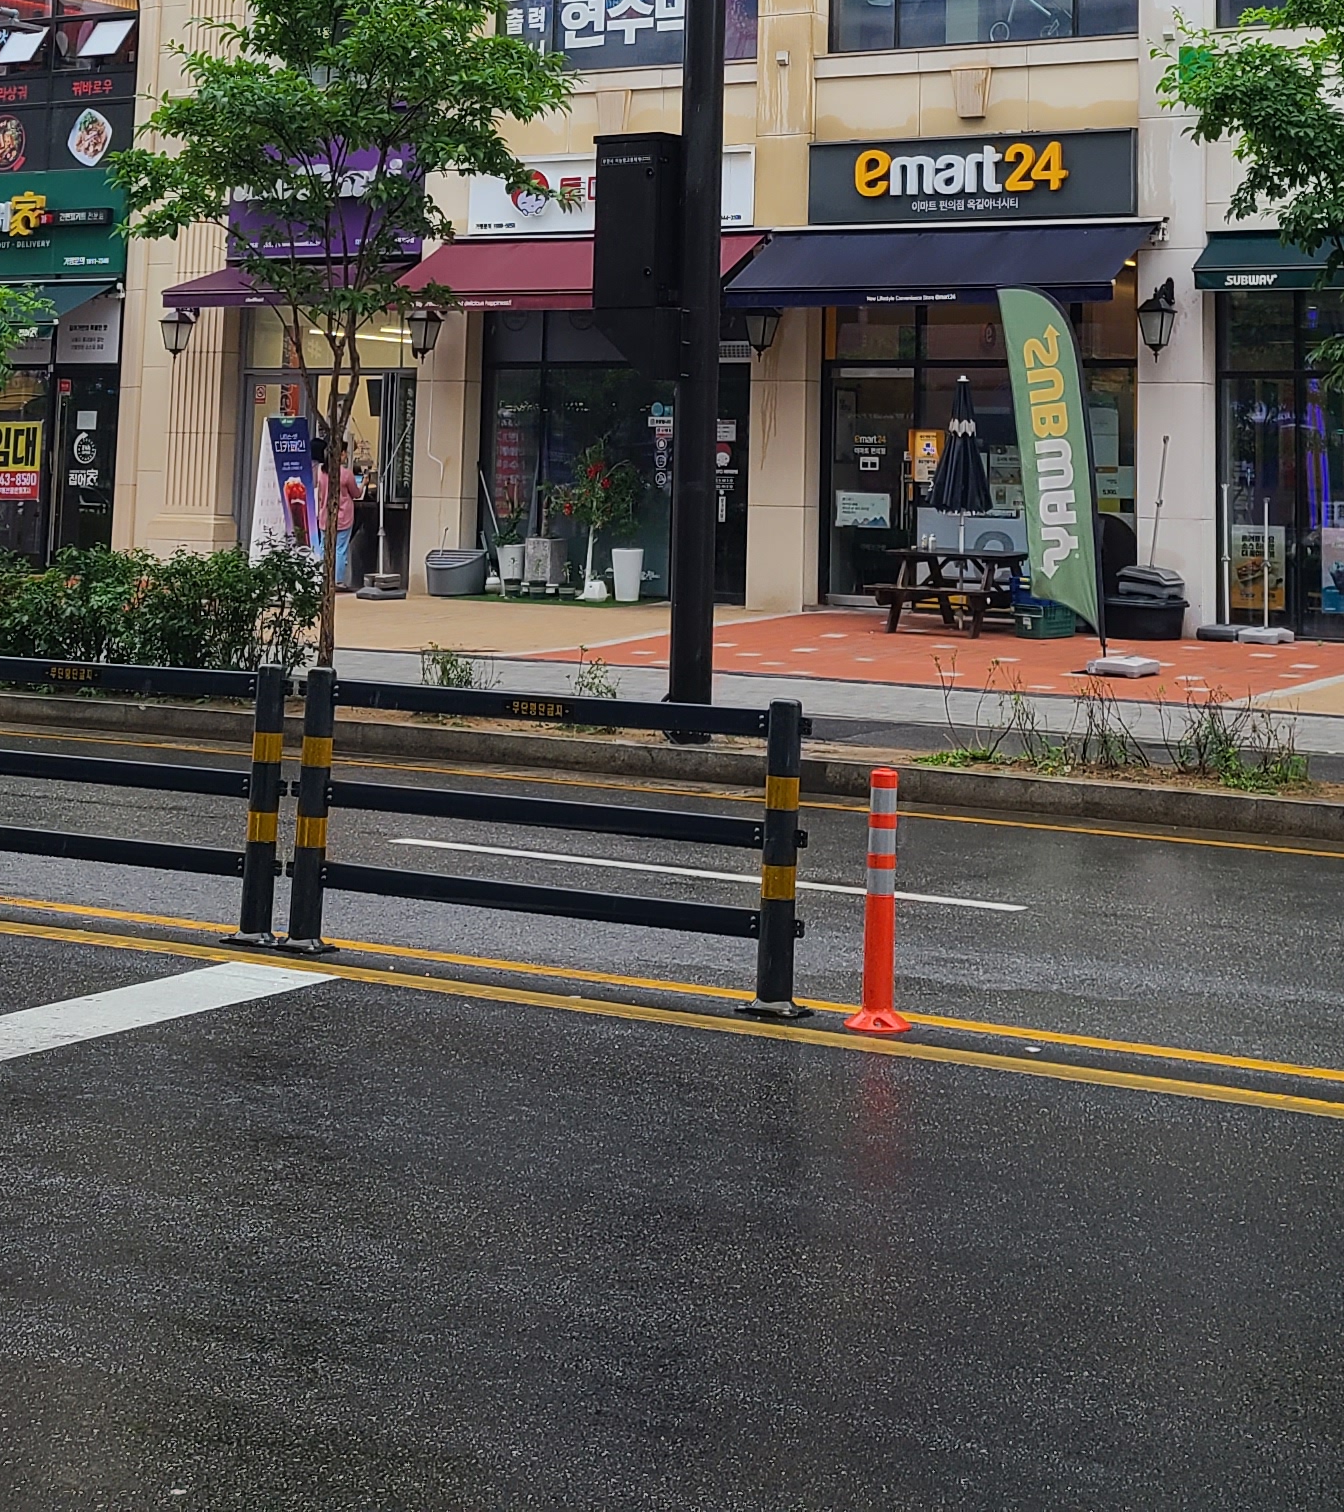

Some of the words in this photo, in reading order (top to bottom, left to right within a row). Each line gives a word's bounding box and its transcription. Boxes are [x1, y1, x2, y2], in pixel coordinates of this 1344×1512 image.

[506, 7, 546, 36] 출력
[854, 140, 1069, 198] emart24
[912, 201, 937, 212] 이마트
[939, 199, 964, 211] 편의점
[967, 197, 1018, 210] 옥길아너시티
[17, 238, 51, 249] DELIVERY
[1225, 274, 1277, 286] SUBWAY
[855, 434, 887, 445] emart24
